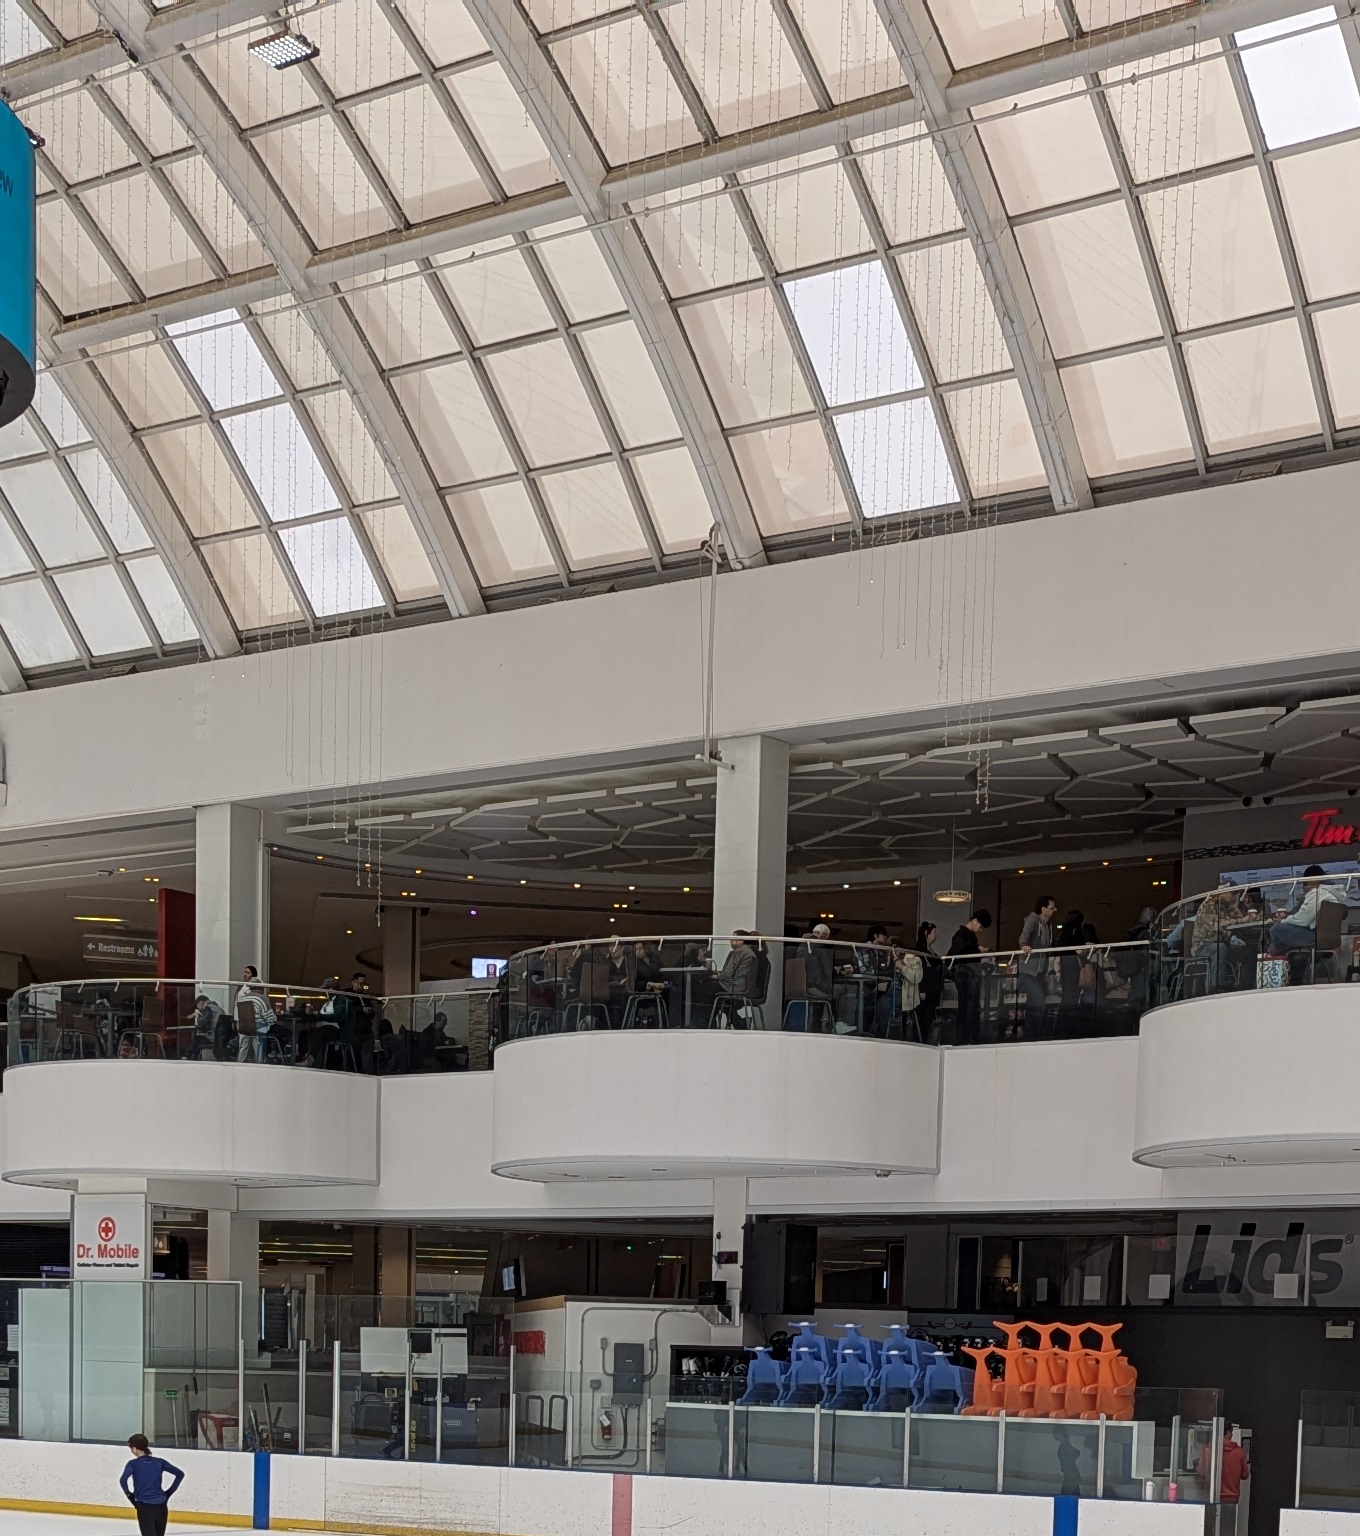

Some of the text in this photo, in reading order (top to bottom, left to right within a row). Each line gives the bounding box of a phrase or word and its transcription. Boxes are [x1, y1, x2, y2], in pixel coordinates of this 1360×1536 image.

[1301, 807, 1355, 848] Tim
[98, 942, 135, 955] Restrooms
[77, 1243, 139, 1259] Dr. Mobile
